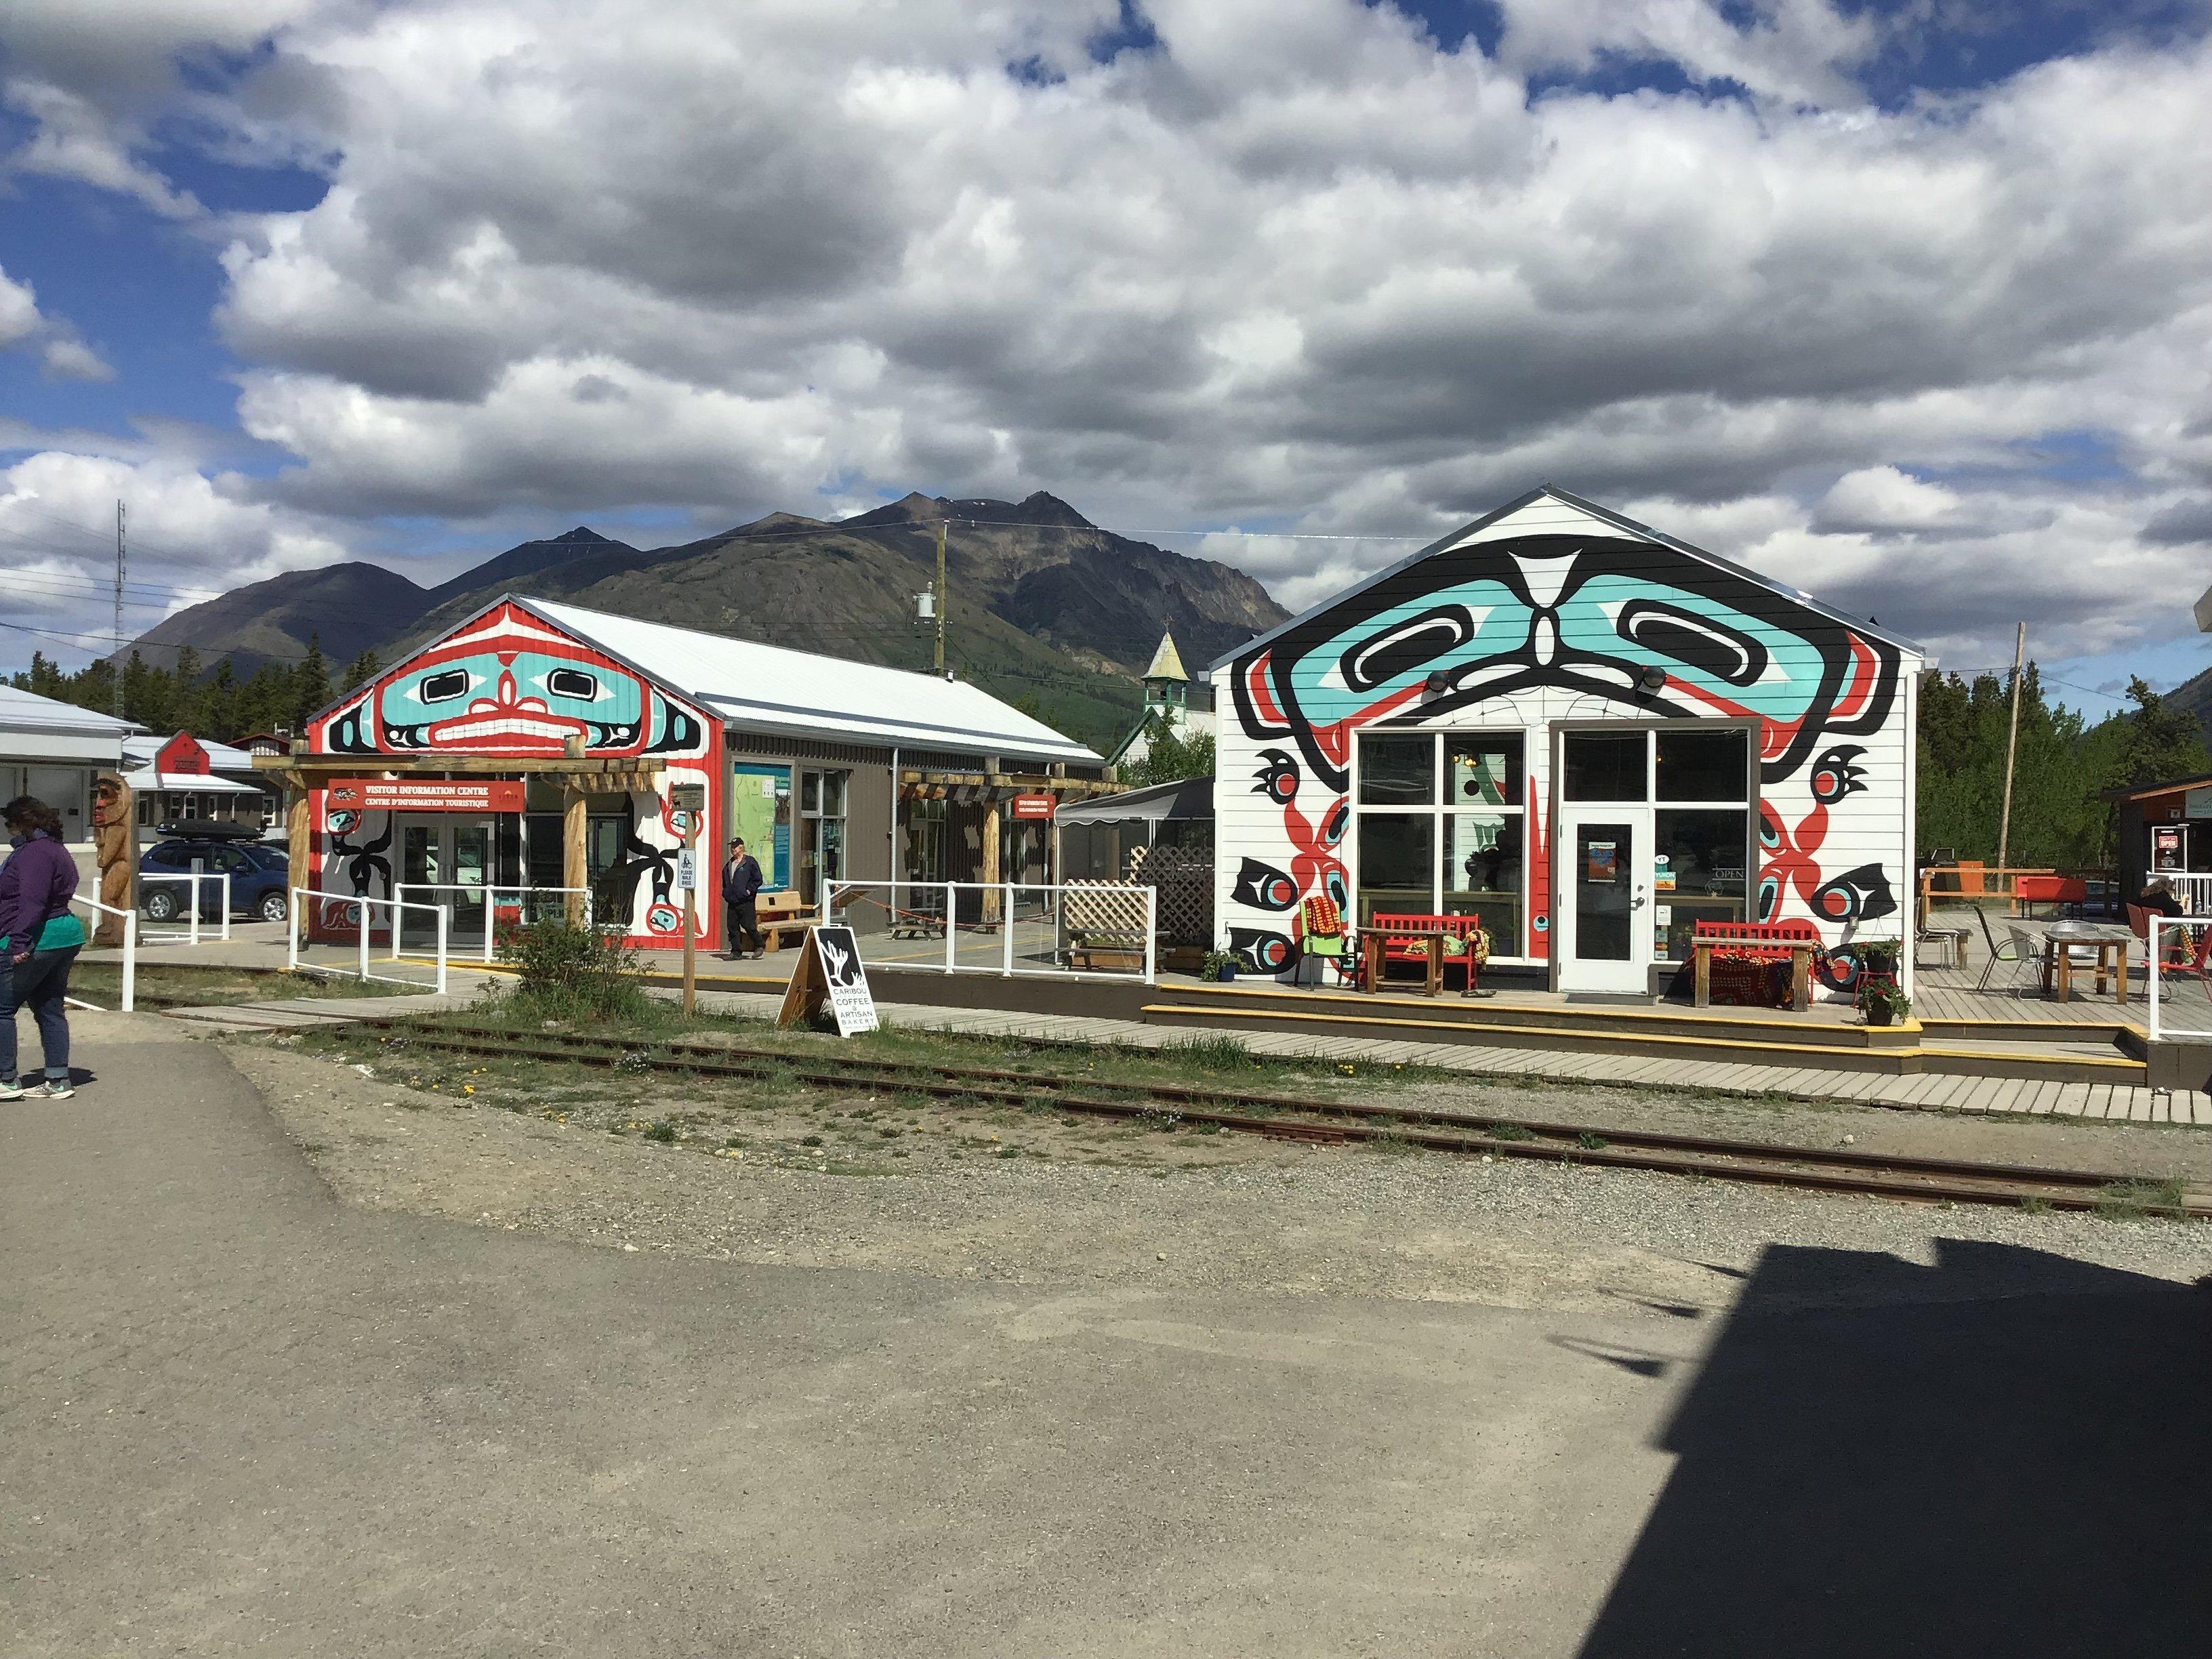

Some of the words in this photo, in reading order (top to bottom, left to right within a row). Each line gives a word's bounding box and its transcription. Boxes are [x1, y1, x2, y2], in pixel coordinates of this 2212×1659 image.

[365, 785, 398, 794] VISITOR
[399, 786, 455, 795] INFORMATION
[457, 787, 489, 796] CENTRE
[445, 800, 489, 808] TOURISTIQUE
[1715, 870, 1744, 879] OPEN
[836, 998, 870, 1006] COFFEE
